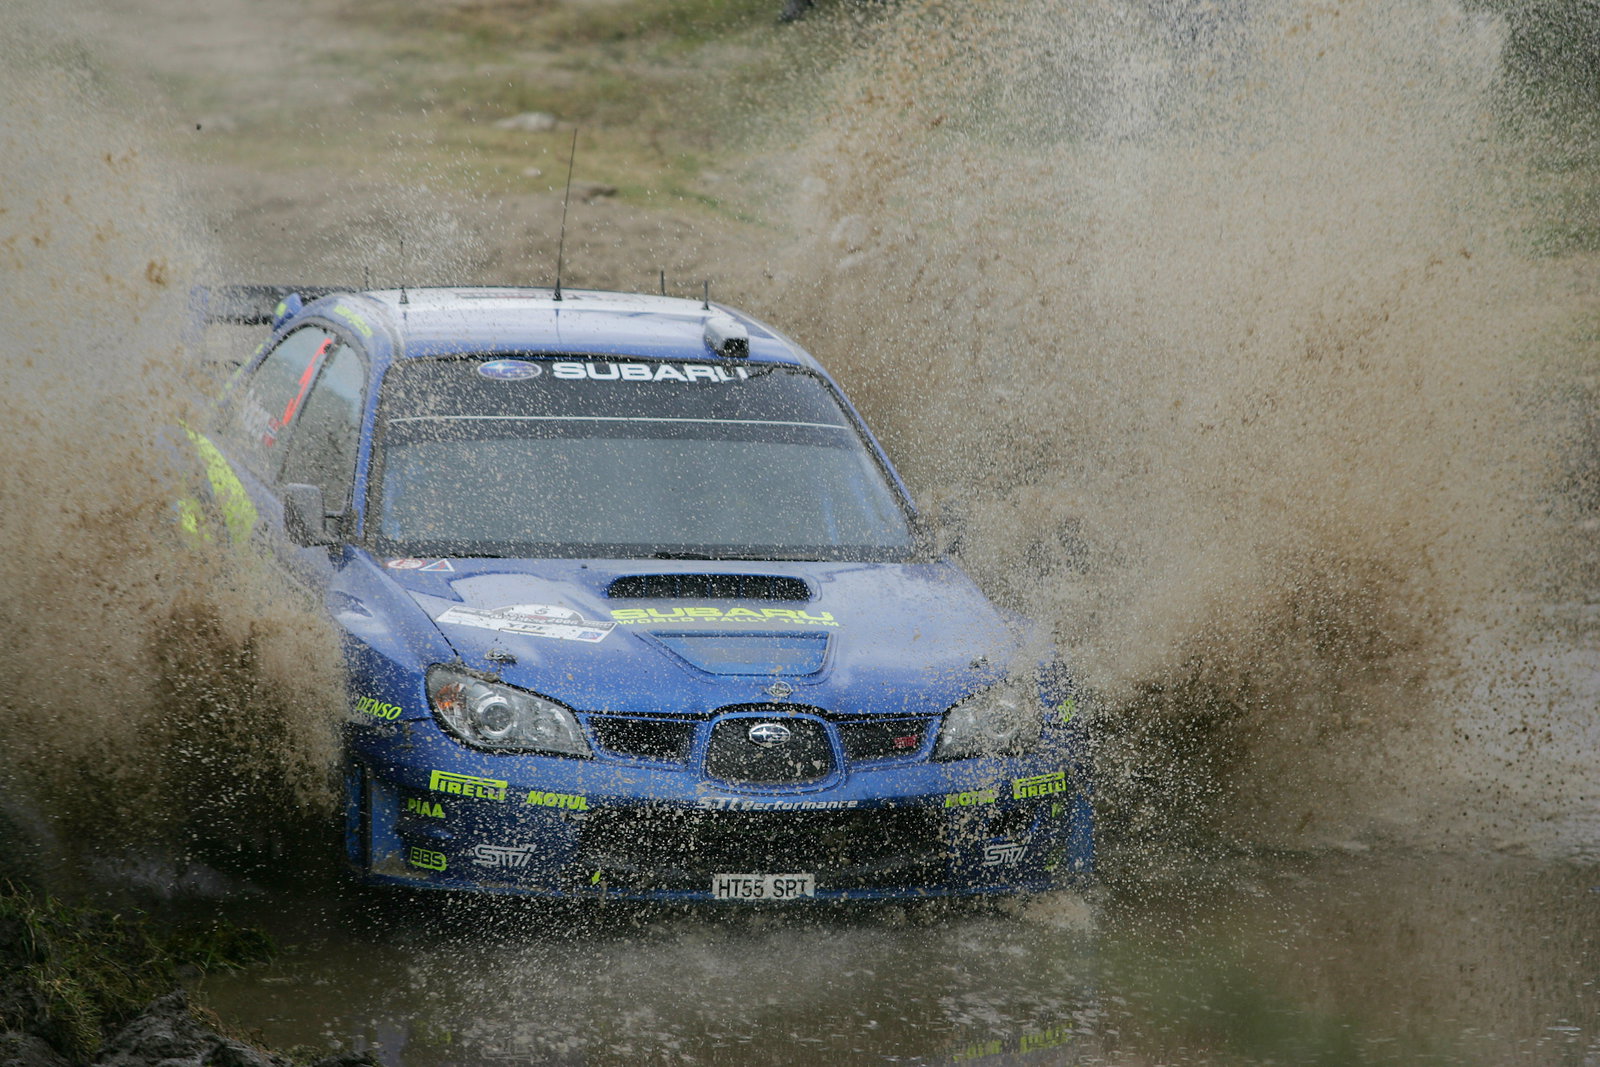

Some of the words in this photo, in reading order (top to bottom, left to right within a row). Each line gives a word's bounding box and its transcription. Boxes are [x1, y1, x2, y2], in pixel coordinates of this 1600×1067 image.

[552, 361, 748, 382] SUBARU
[610, 607, 835, 621] SUBARU
[617, 617, 695, 625] WORLD
[783, 619, 840, 627] TEAM
[356, 695, 403, 720] DENSO
[430, 769, 508, 801] PIRELLI
[407, 798, 446, 819] PIAA
[526, 789, 589, 811] MOTUL
[740, 799, 858, 811] Performance
[411, 847, 447, 871] BBS
[718, 878, 765, 898] HT55
